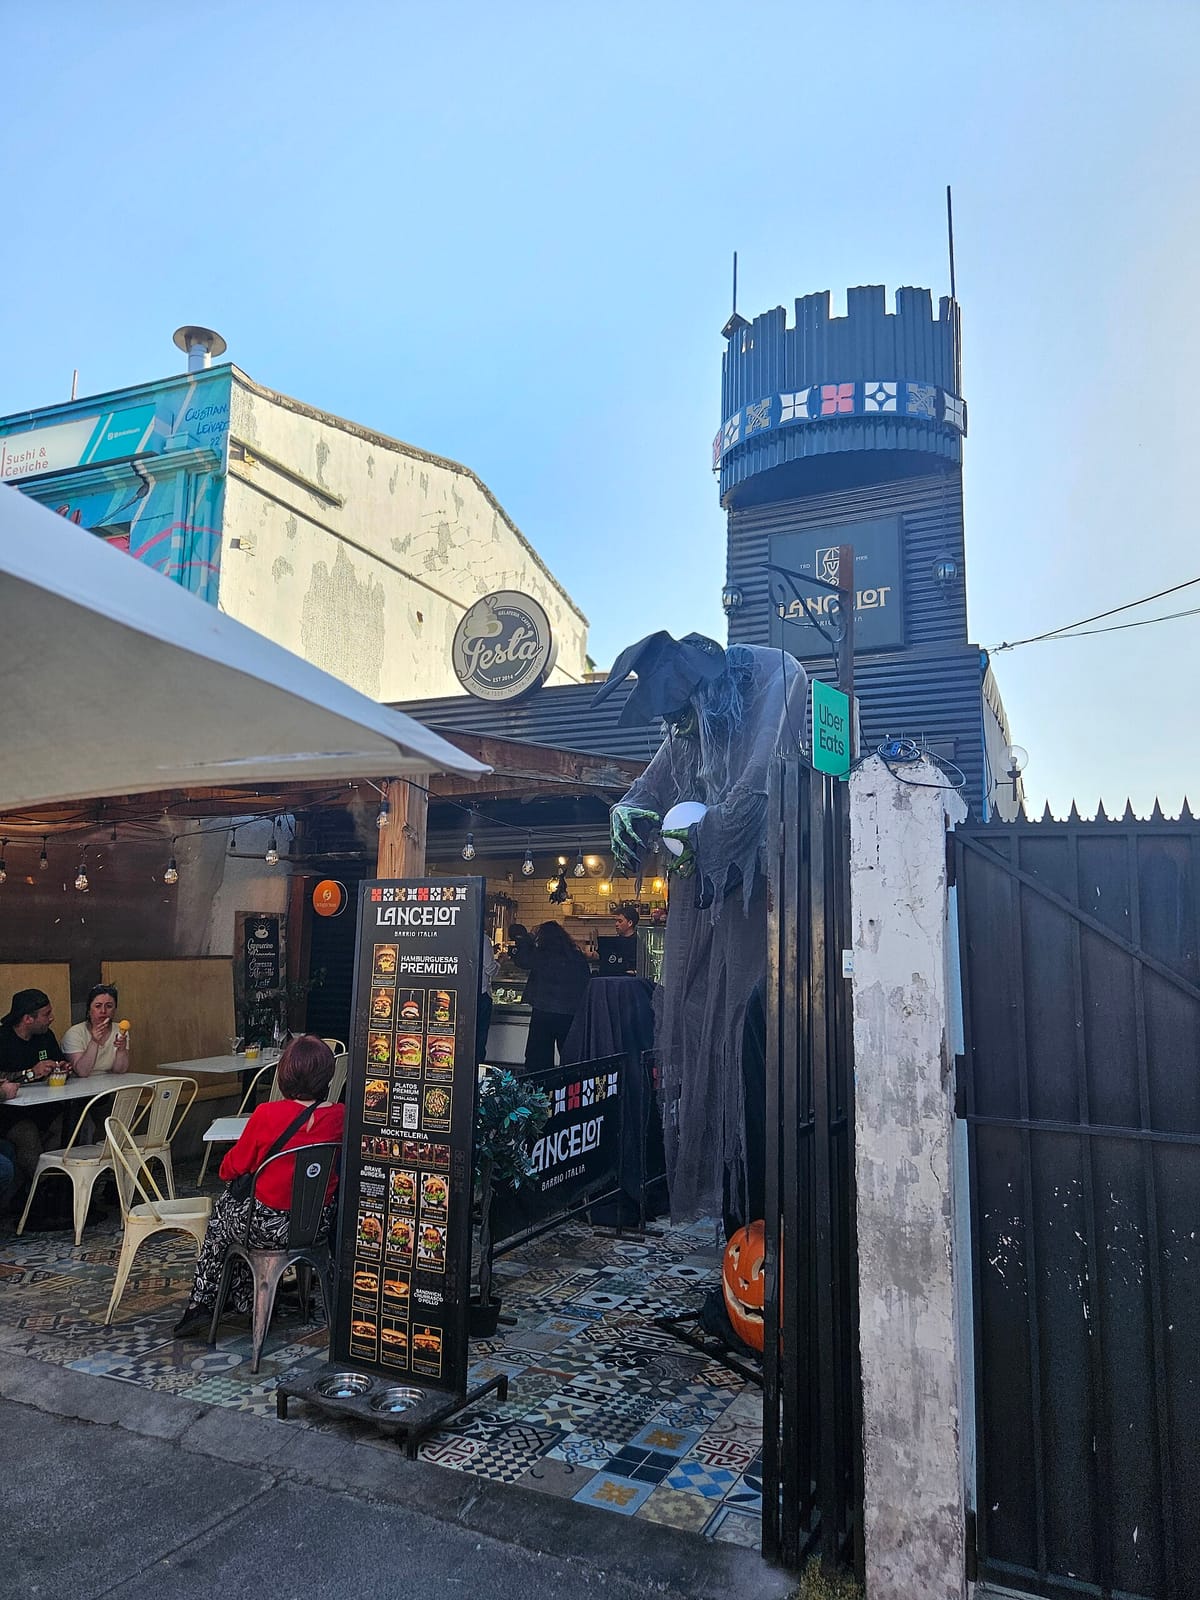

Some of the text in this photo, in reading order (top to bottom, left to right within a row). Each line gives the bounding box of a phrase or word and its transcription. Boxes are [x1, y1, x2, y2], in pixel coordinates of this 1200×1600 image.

[6, 447, 47, 465] Sushi &
[5, 460, 49, 477] Ceviche
[778, 586, 891, 620] LANCLOT
[819, 704, 844, 732] Uber
[819, 727, 845, 756] Eats
[376, 906, 461, 926] LANCELOT
[400, 955, 459, 963] HAMBURGUESAS
[400, 963, 458, 975] PREMIUM
[392, 1087, 420, 1096] PREMIUM
[395, 1082, 417, 1090] PLATOS
[541, 1164, 586, 1192] BARRIO ITALIA
[413, 1292, 444, 1303] CHURRASCO
[415, 1288, 442, 1297] SANDWICH
